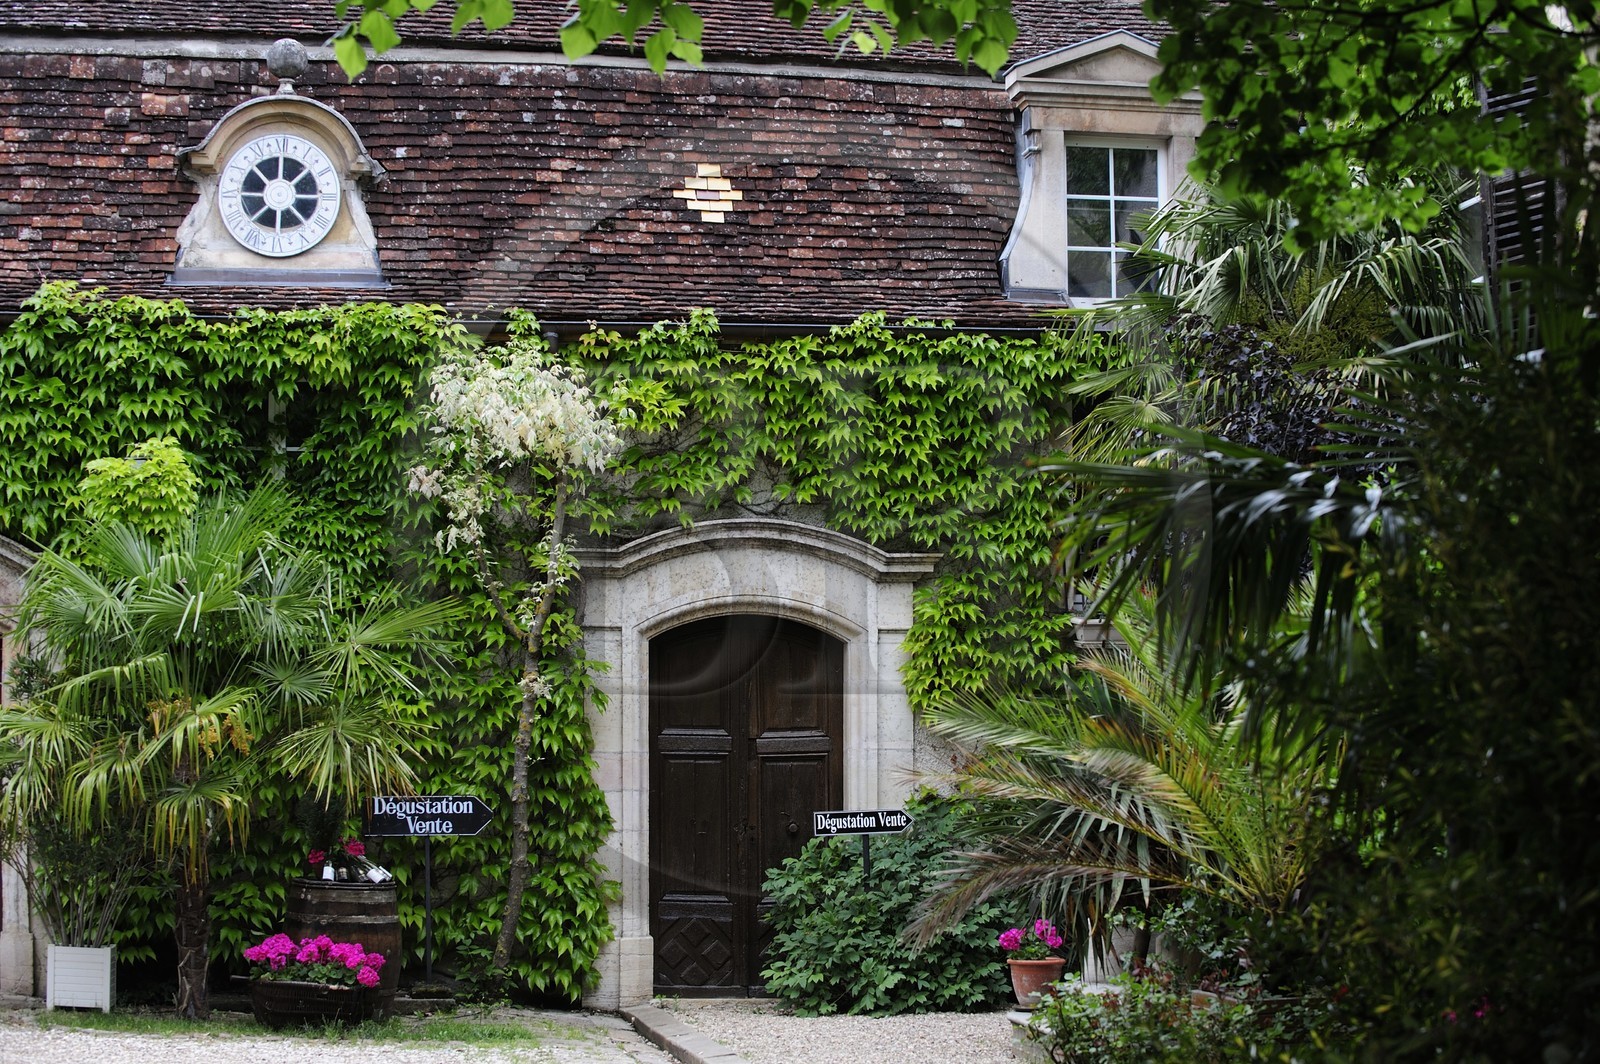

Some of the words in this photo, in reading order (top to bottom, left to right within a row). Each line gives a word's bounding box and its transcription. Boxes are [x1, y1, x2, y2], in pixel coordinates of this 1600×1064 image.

[374, 797, 474, 819] Dégustation
[406, 816, 453, 834] Vente
[817, 812, 876, 833] Dégustation
[878, 811, 907, 827] Vente
